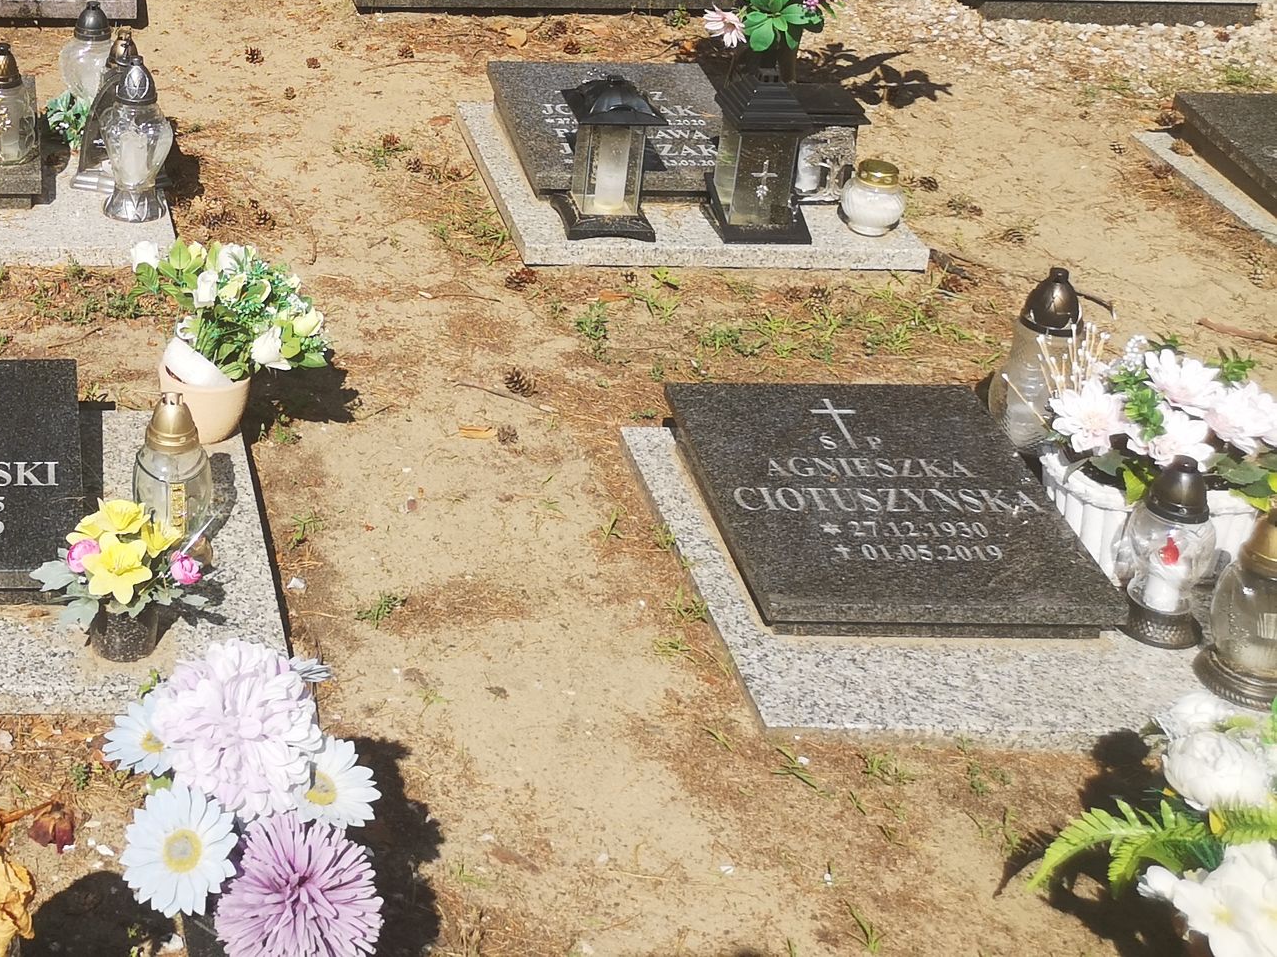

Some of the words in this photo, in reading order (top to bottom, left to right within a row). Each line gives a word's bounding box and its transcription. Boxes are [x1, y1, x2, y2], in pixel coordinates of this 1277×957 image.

[866, 436, 883, 450] P
[767, 456, 977, 479] AGNIESZKA
[847, 521, 989, 538] 27.12.1930
[860, 544, 1003, 561] 01.05.2019
